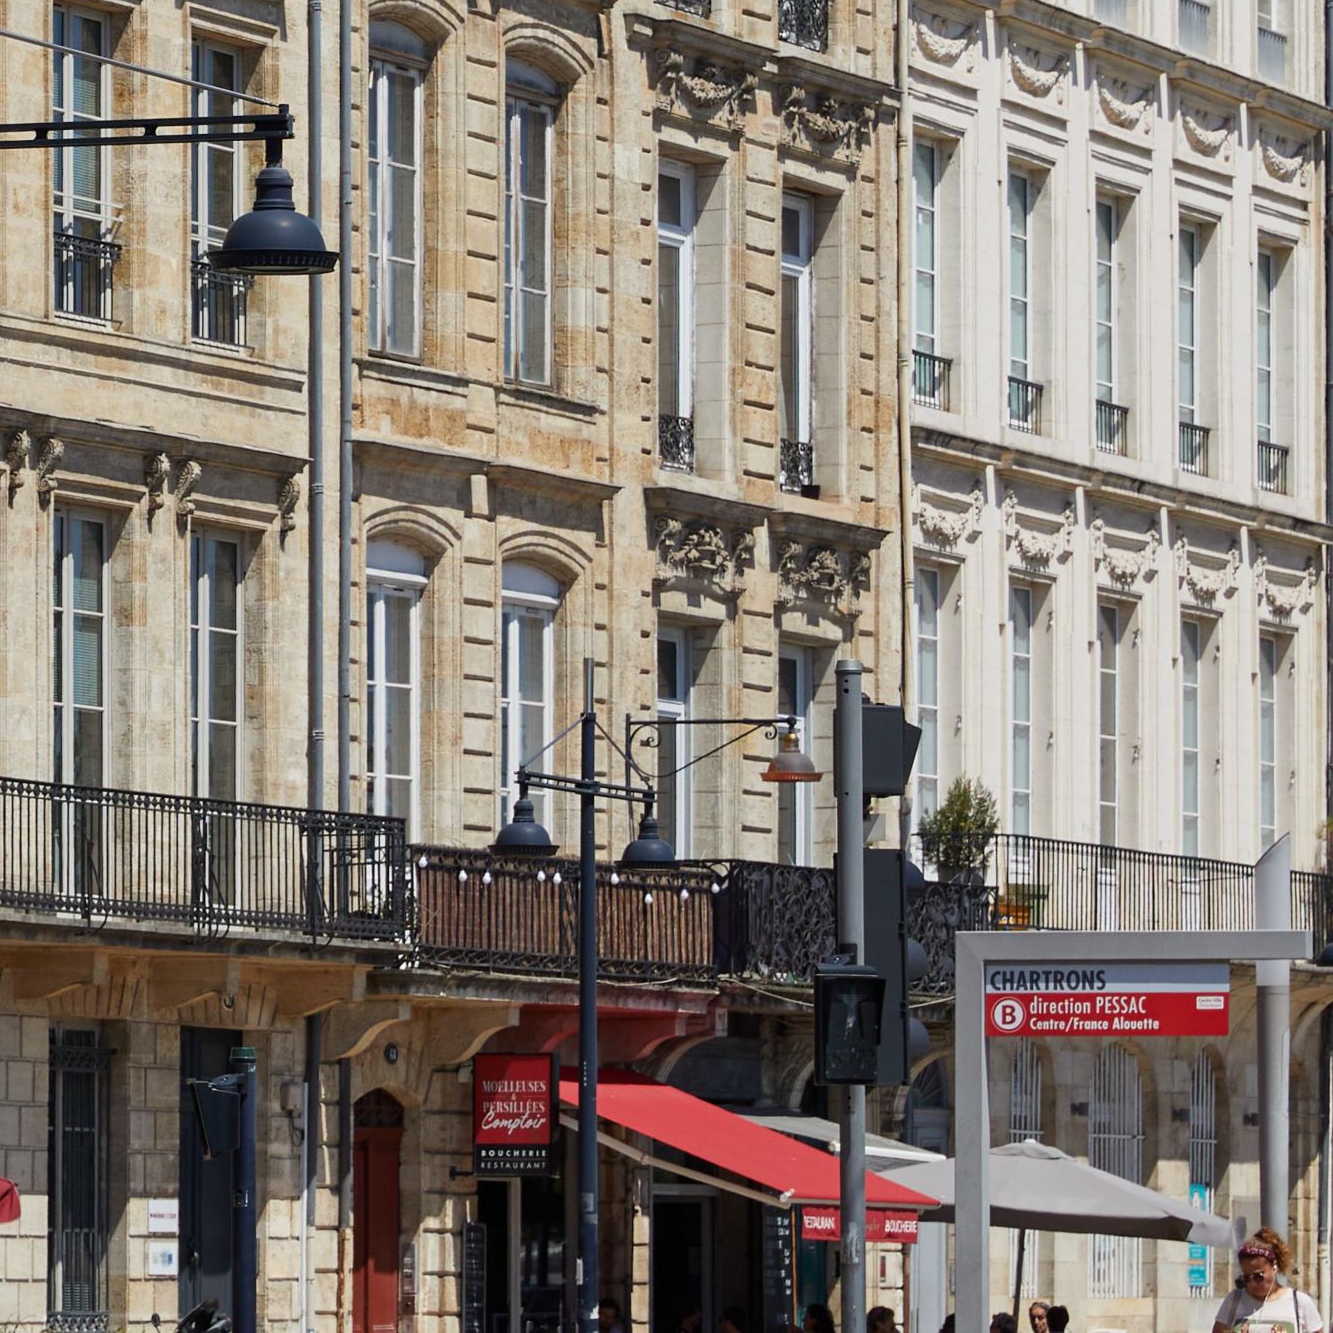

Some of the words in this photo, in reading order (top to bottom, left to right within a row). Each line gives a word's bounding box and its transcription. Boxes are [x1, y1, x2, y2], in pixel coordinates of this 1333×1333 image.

[990, 970, 1106, 991] CHARTRONS
[1029, 996, 1091, 1014] direction
[1095, 996, 1146, 1014] PESSAC
[1001, 1004, 1016, 1025] B
[1029, 1017, 1109, 1032] Centre/France
[1112, 1017, 1159, 1030] Alouette
[483, 1080, 546, 1093] MOELLEUSES
[483, 1099, 545, 1113] PERSILLÉES
[482, 1109, 546, 1135] Comptoir
[885, 1220, 917, 1233] BOUCHERIE
